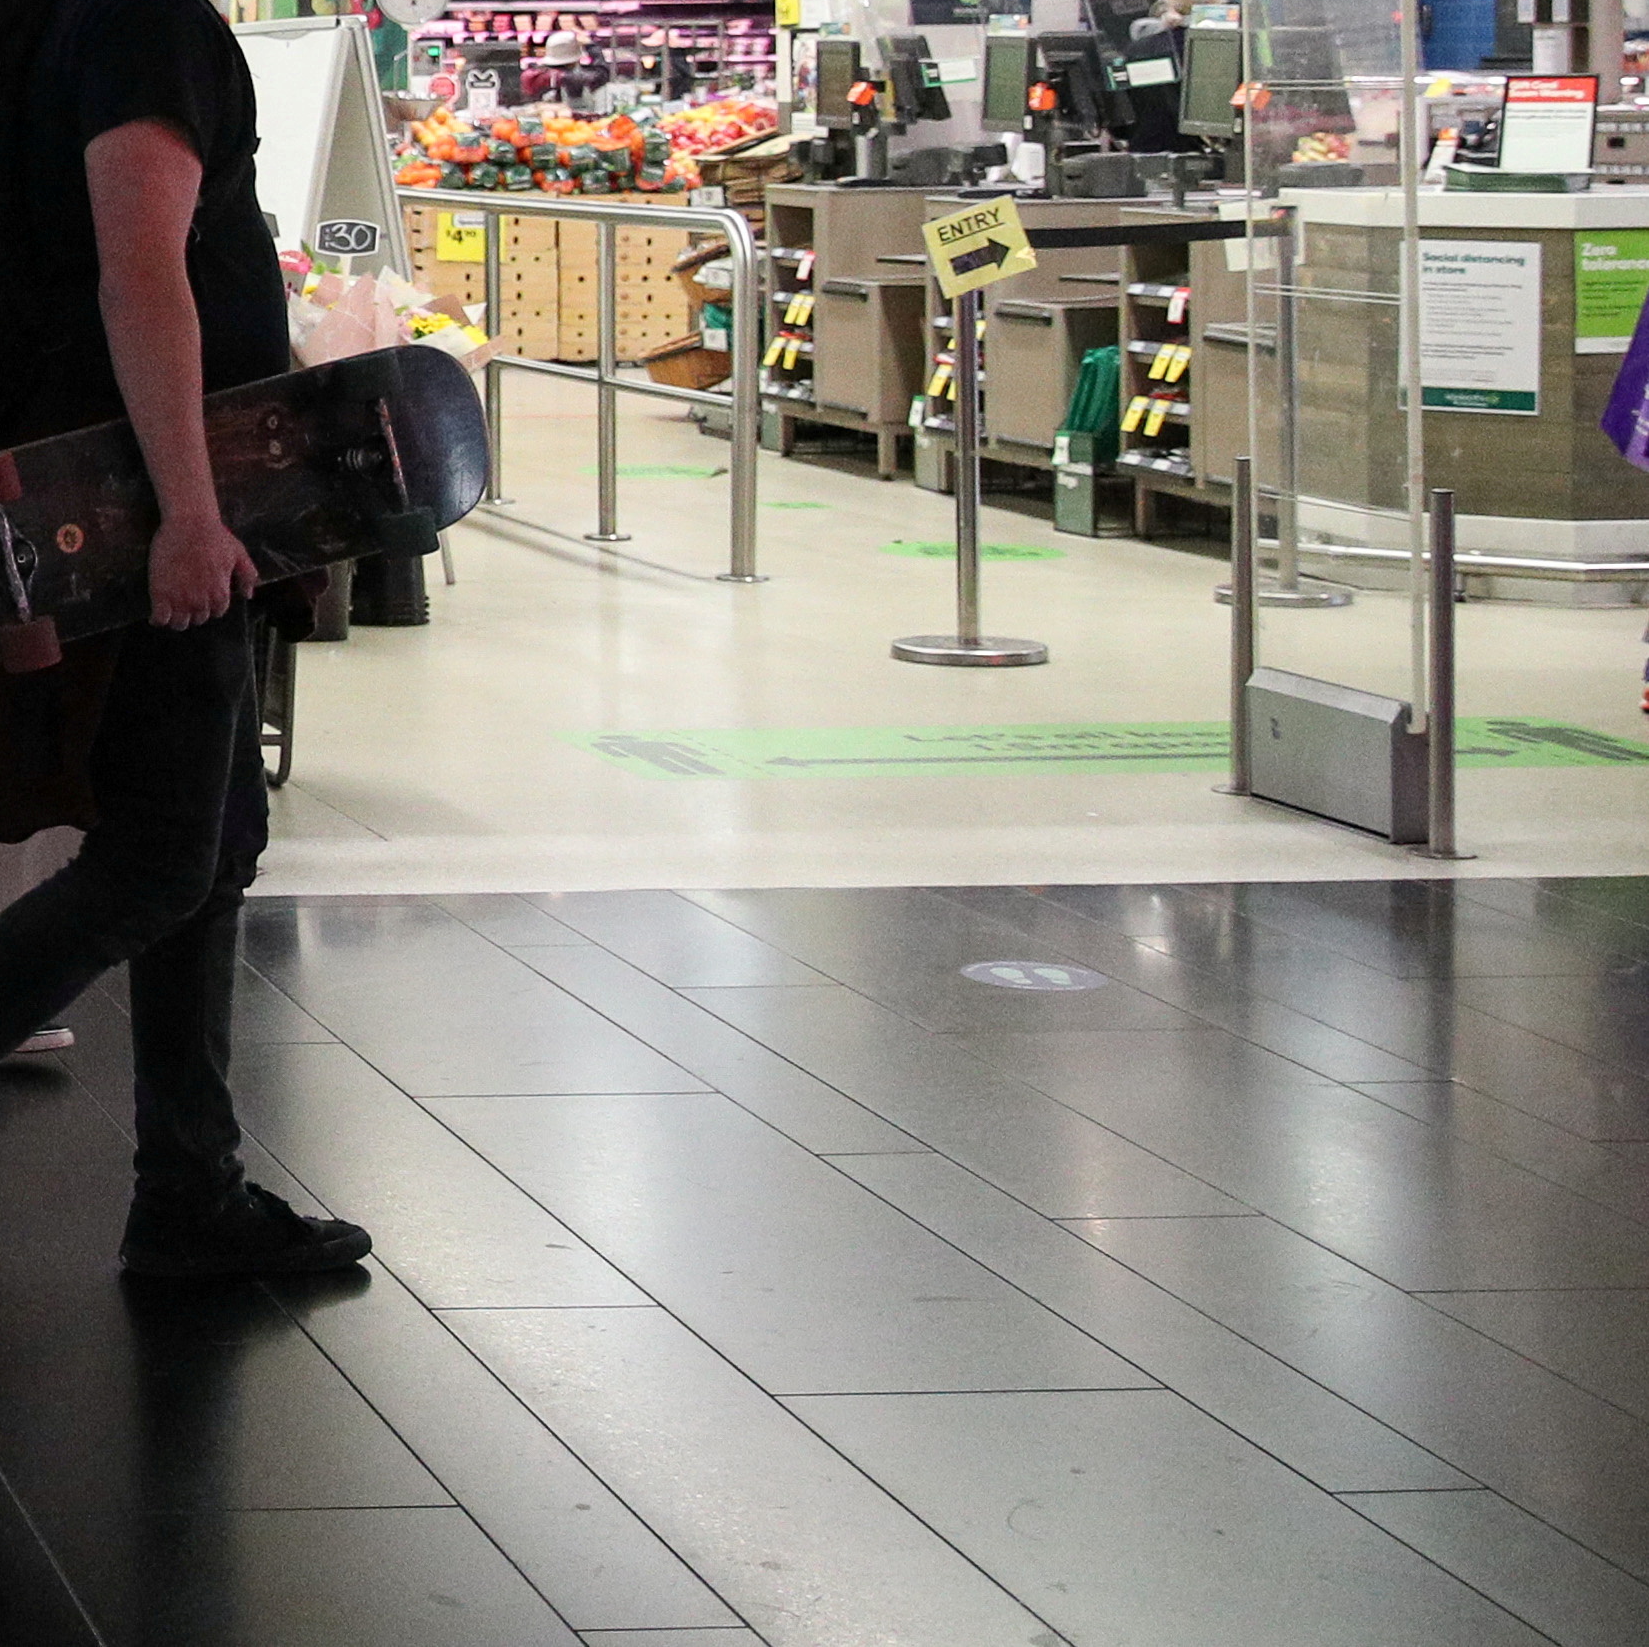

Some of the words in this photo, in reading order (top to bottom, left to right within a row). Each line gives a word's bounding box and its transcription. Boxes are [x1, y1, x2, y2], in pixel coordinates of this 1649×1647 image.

[937, 208, 999, 242] ENTRY
[1423, 253, 1459, 263] Social
[1461, 254, 1525, 266] distancing
[1436, 266, 1466, 274] store
